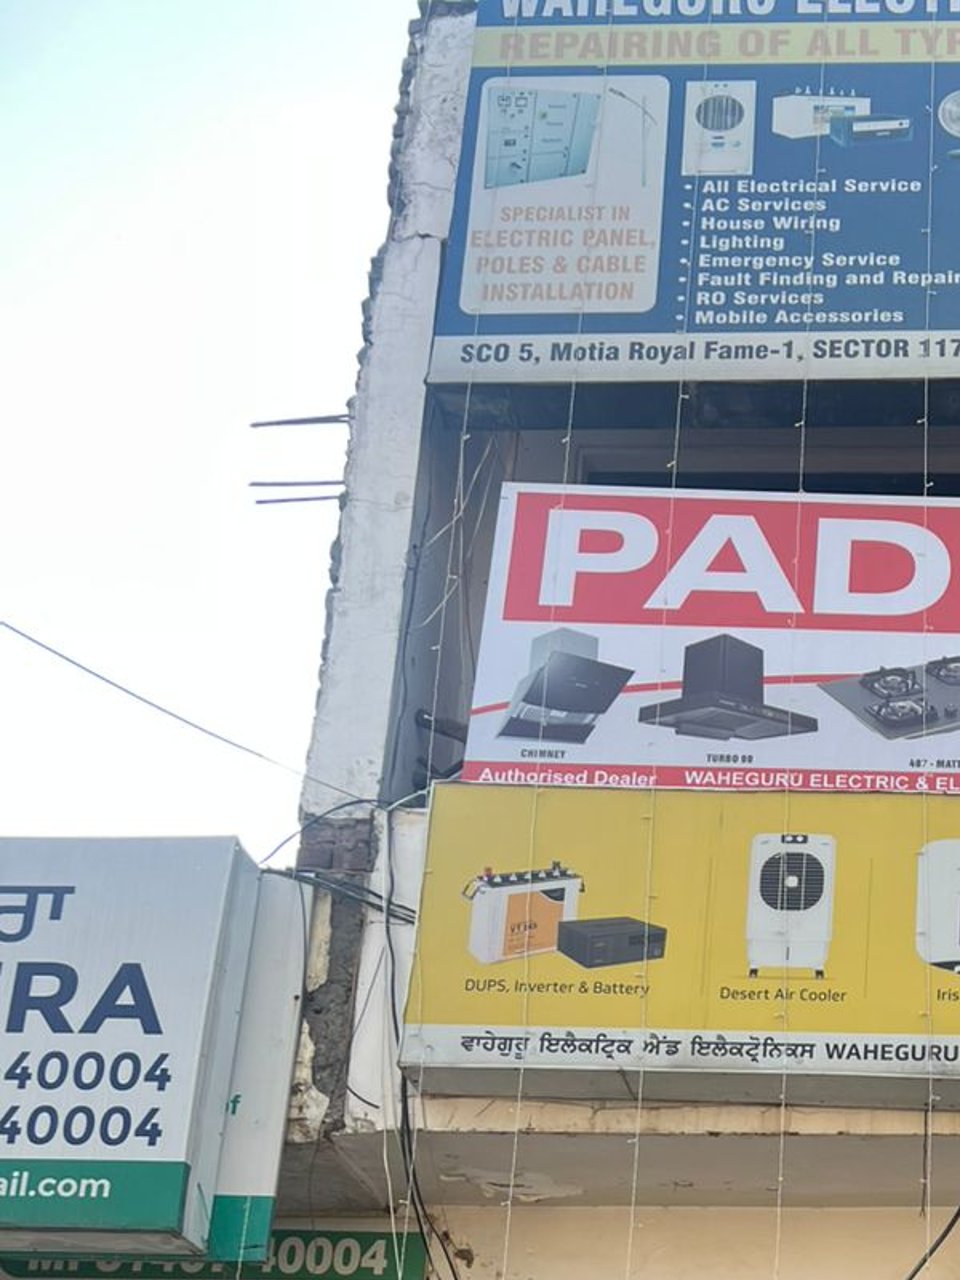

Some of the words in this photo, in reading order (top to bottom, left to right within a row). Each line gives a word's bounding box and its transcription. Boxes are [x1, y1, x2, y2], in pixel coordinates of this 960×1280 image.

[502, 29, 722, 62] REPAIRING
[738, 29, 791, 58] OF
[806, 28, 880, 57] ALL
[702, 180, 729, 193] All
[737, 179, 836, 193] Electrical
[844, 179, 922, 193] Service
[702, 199, 730, 212] AC
[737, 198, 827, 212] Services
[500, 206, 602, 222] SPECIALIST
[612, 206, 630, 221] IN
[701, 217, 765, 231] House
[773, 216, 841, 232] Wiring
[470, 229, 573, 248] ELECTRIC
[582, 229, 656, 249] PANEL,
[700, 235, 784, 251] Lighting
[476, 256, 545, 274] POLES
[552, 256, 568, 274] &
[576, 255, 647, 274] CABLE
[699, 253, 814, 269] Emergency
[822, 253, 901, 267] Service
[697, 273, 751, 286] Fault
[759, 272, 838, 288] Finding
[845, 271, 885, 284] and
[481, 281, 634, 301] INSTALLATION
[696, 292, 726, 305] RO
[734, 291, 825, 305] Services
[695, 310, 768, 325] Mobile
[774, 309, 904, 324] Accessories
[460, 343, 510, 363] SCO
[518, 343, 541, 365] 5,
[550, 342, 619, 361] Motia
[629, 341, 695, 365] Royal
[704, 340, 803, 362] Fame-1,
[813, 339, 910, 358] SECTOR
[521, 749, 566, 759] CHIMNEY
[479, 767, 587, 785] Authorised
[594, 769, 657, 787] Dealer
[685, 771, 803, 787] WAHEGURU
[809, 773, 909, 790] ELECTRIC
[916, 777, 930, 790] &
[465, 979, 510, 995] DUPS,
[514, 980, 574, 995] Inverter
[578, 982, 589, 994] &
[593, 982, 650, 999] Battery
[720, 987, 769, 1001] Desert
[773, 987, 795, 1001] Air
[799, 988, 847, 1003] Cooler
[937, 988, 960, 1002] Iris
[0, 961, 164, 1035] RA
[825, 1042, 959, 1062] WAHEGURU
[3, 1050, 172, 1092] 40004
[0, 1105, 163, 1147] 40004
